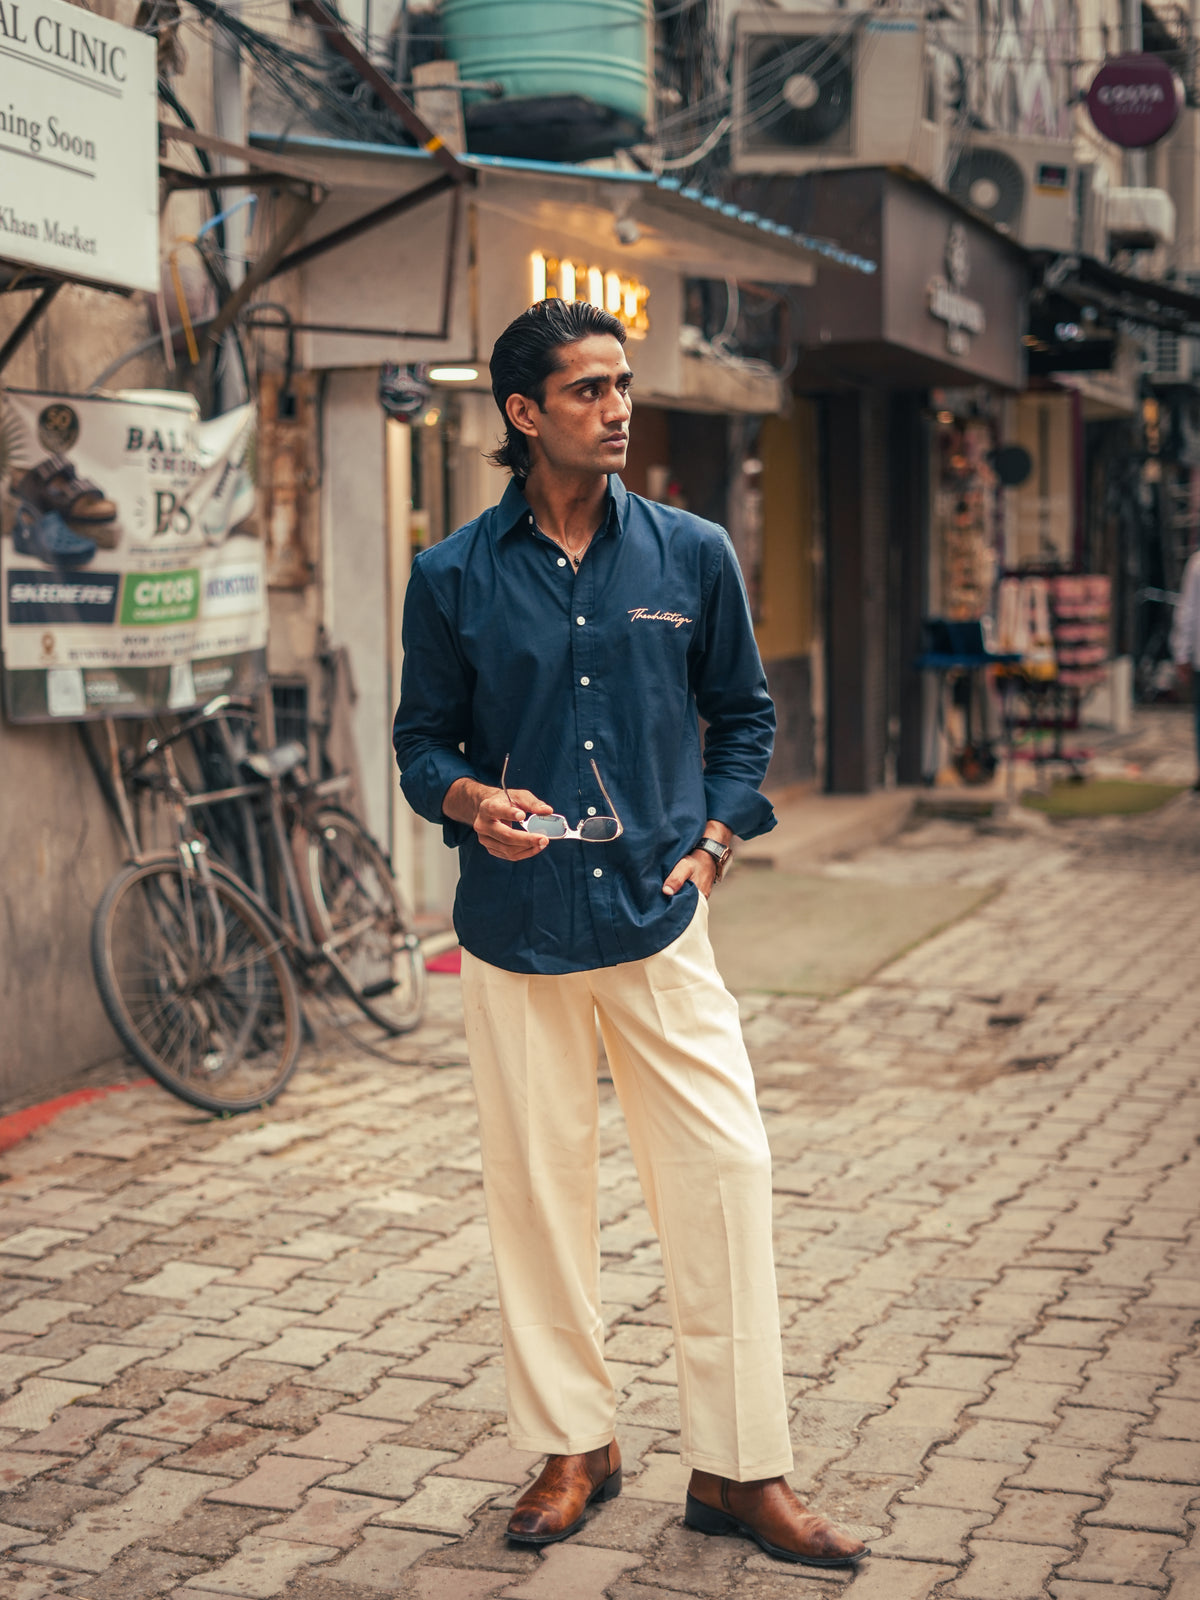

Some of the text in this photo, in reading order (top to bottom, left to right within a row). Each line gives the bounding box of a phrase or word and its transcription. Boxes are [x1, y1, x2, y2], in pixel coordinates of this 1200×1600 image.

[34, 15, 127, 83] CLINIC
[47, 116, 96, 160] Soon
[0, 206, 97, 255] Khan Market
